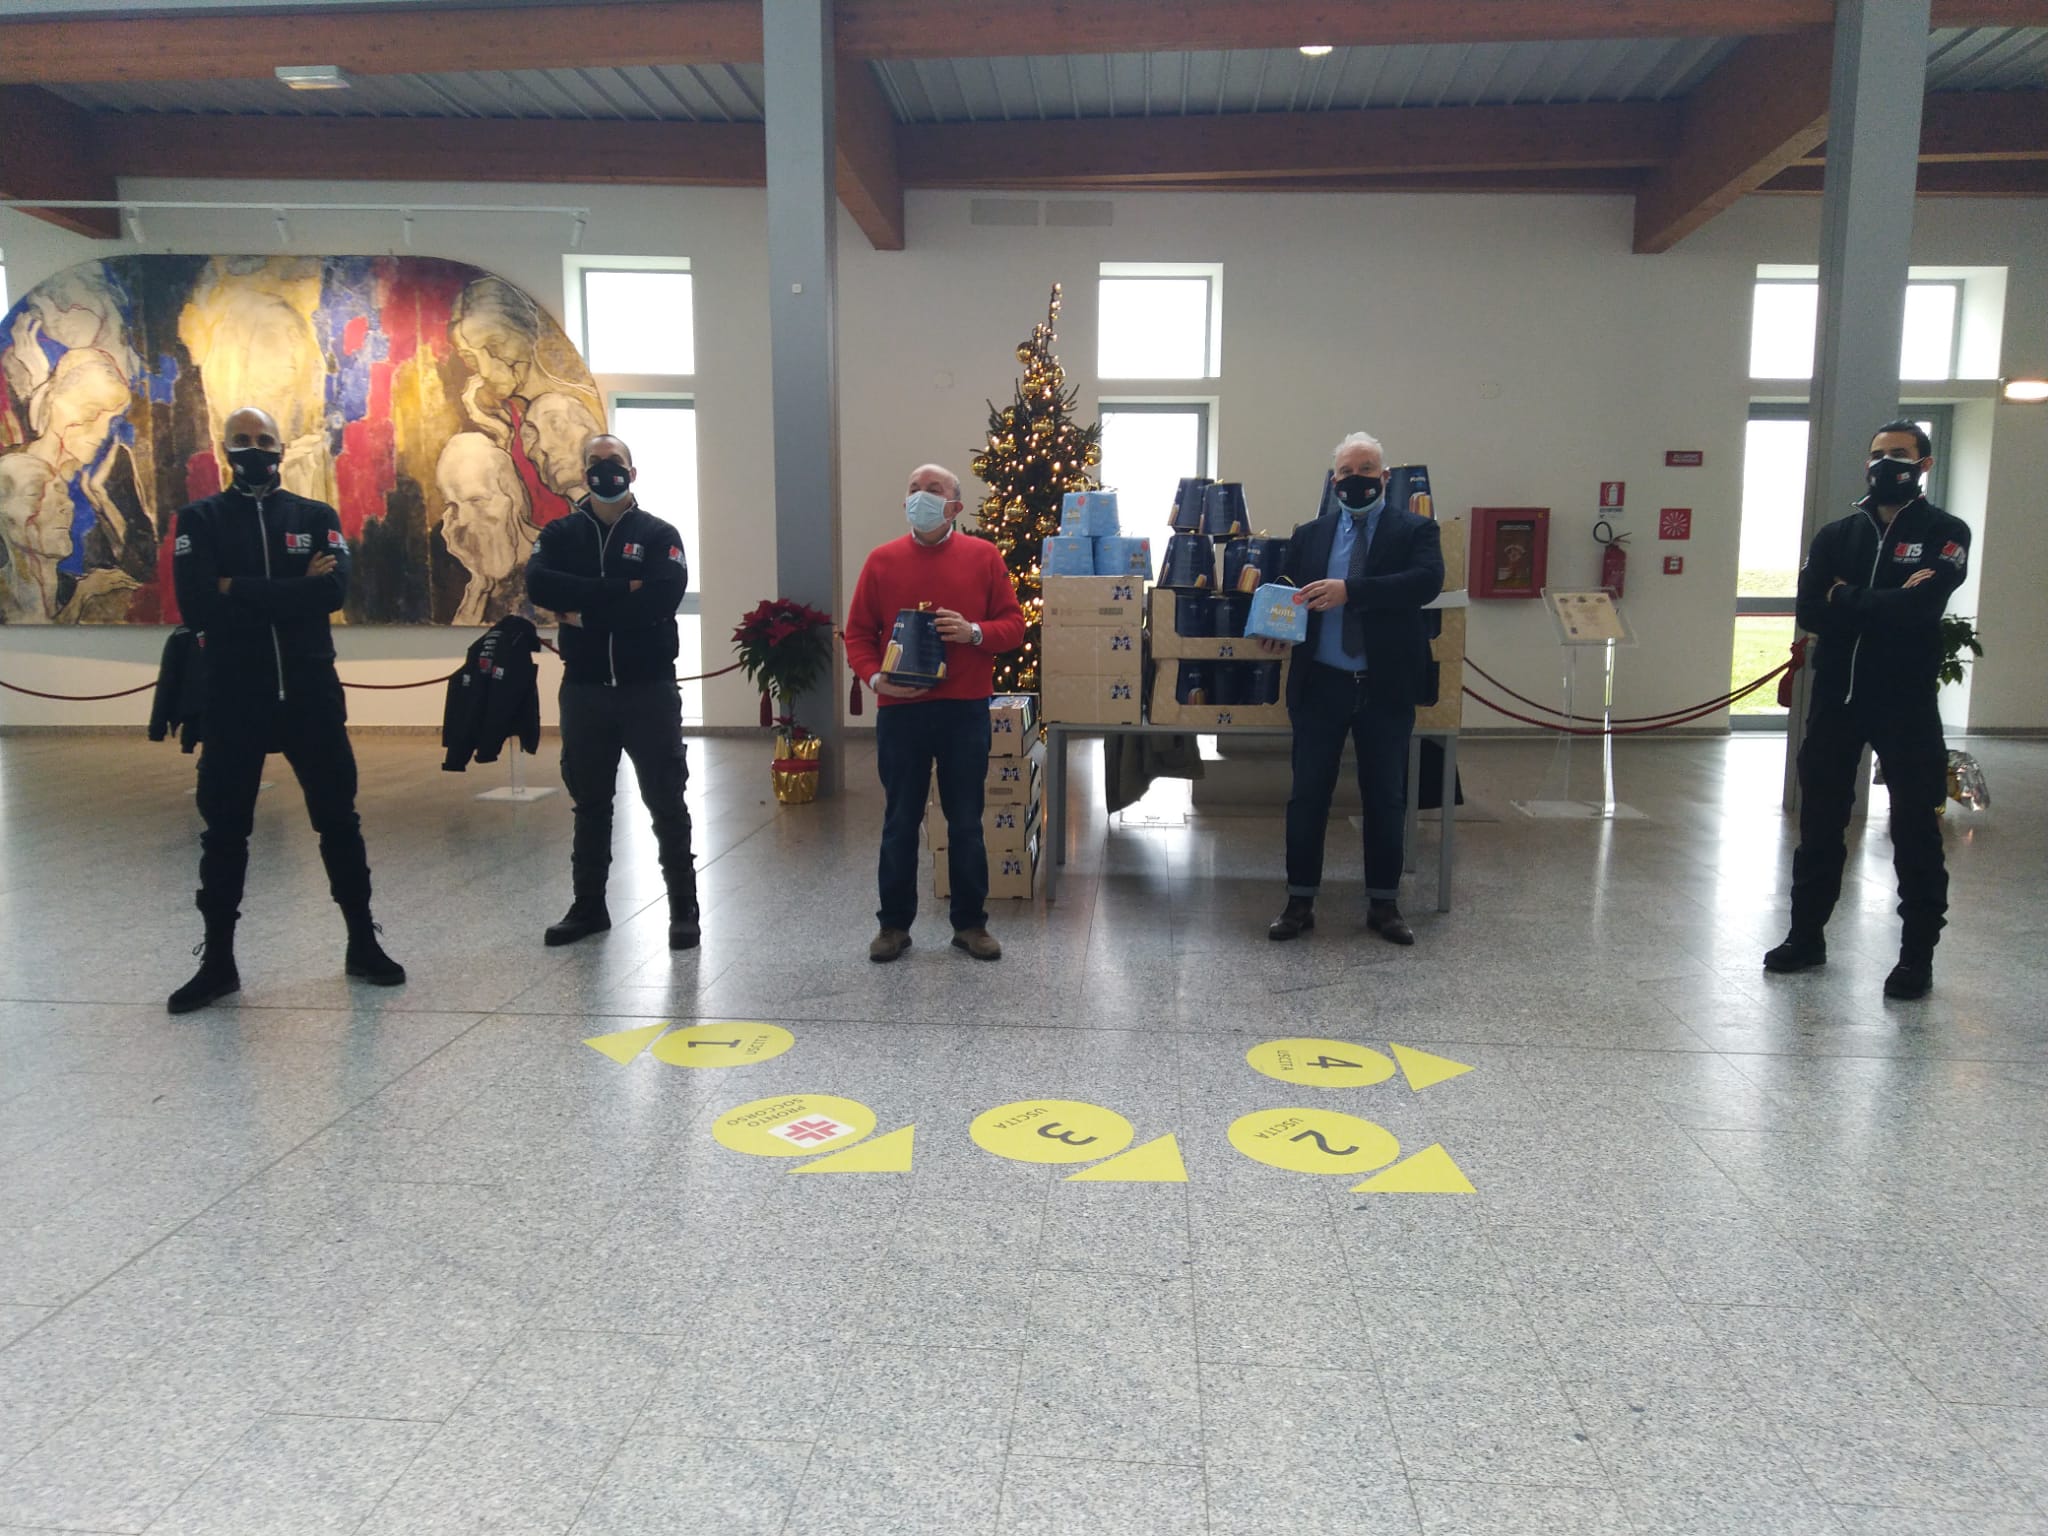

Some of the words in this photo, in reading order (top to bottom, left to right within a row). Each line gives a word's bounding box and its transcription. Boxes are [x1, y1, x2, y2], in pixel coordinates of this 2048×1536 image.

[1306, 1055, 1363, 1069] 4
[726, 1097, 804, 1127] SOCCORSO
[747, 1105, 808, 1127] PRONTO
[992, 1107, 1049, 1129] USCITA
[1037, 1121, 1099, 1146] 3
[1253, 1116, 1305, 1139] USCITA
[1288, 1129, 1360, 1156] 2
